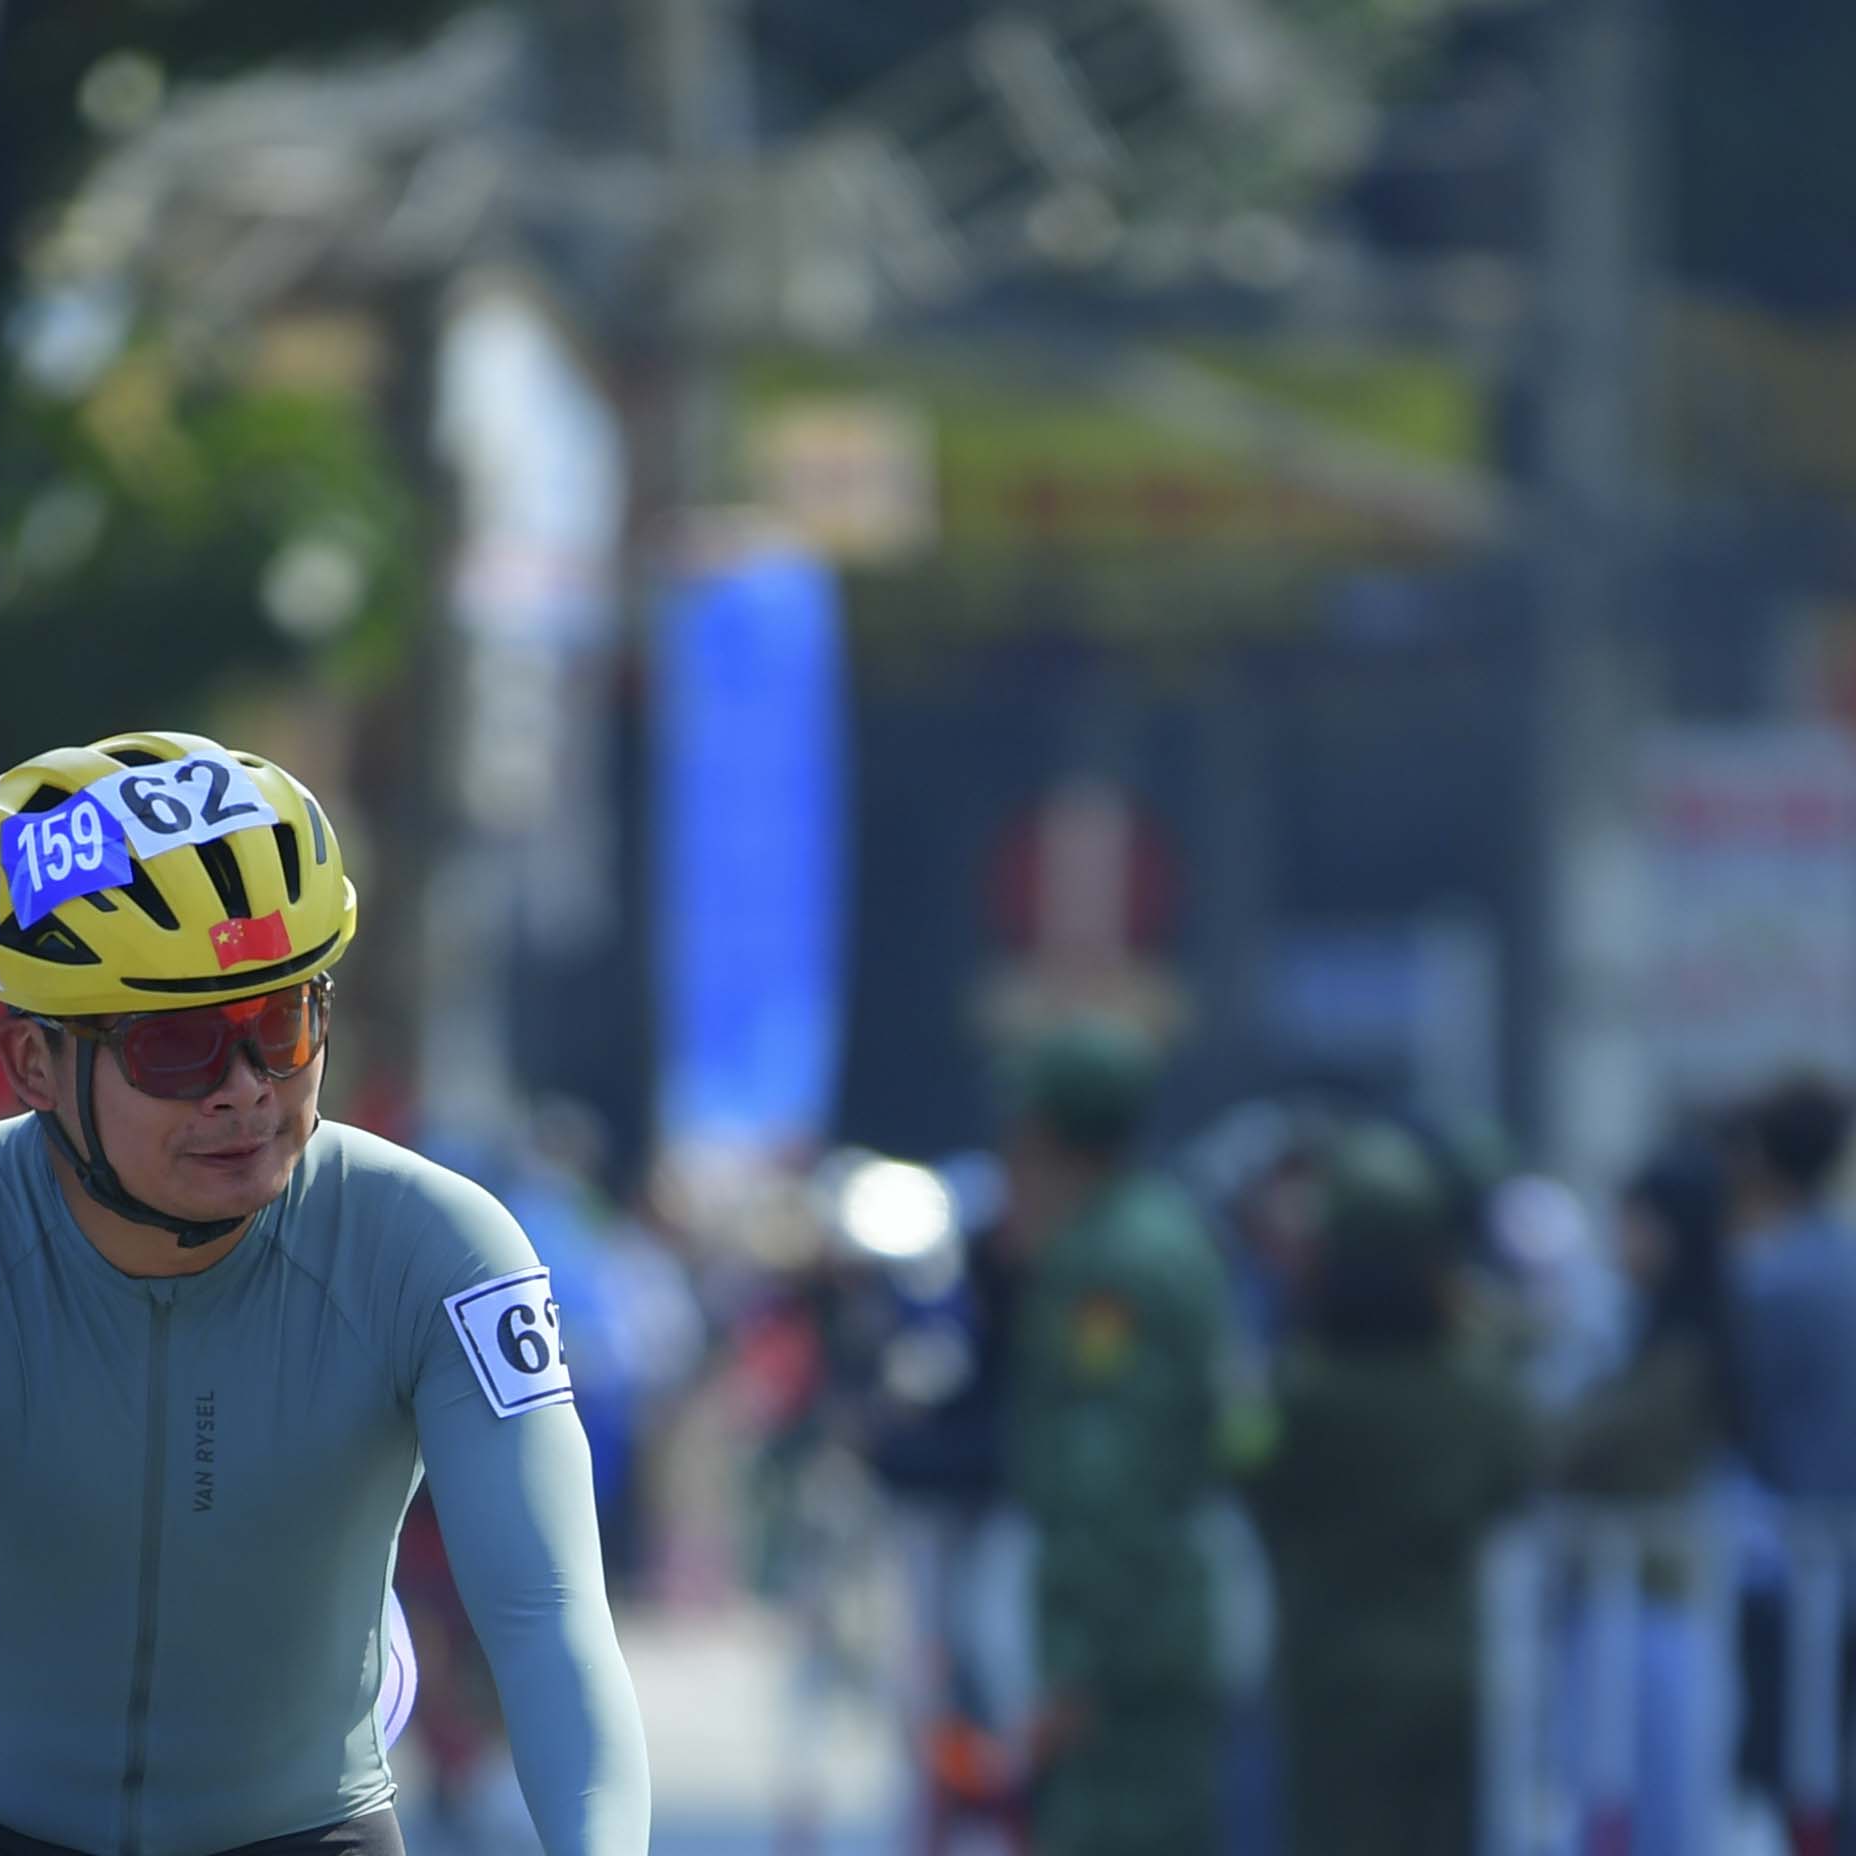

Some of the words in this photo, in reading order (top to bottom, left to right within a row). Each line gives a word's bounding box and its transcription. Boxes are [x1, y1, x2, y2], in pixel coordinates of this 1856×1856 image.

[119, 760, 259, 834] 62
[17, 801, 104, 892] 159
[194, 1391, 215, 1462] RYSEL
[193, 1471, 215, 1512] VAN
